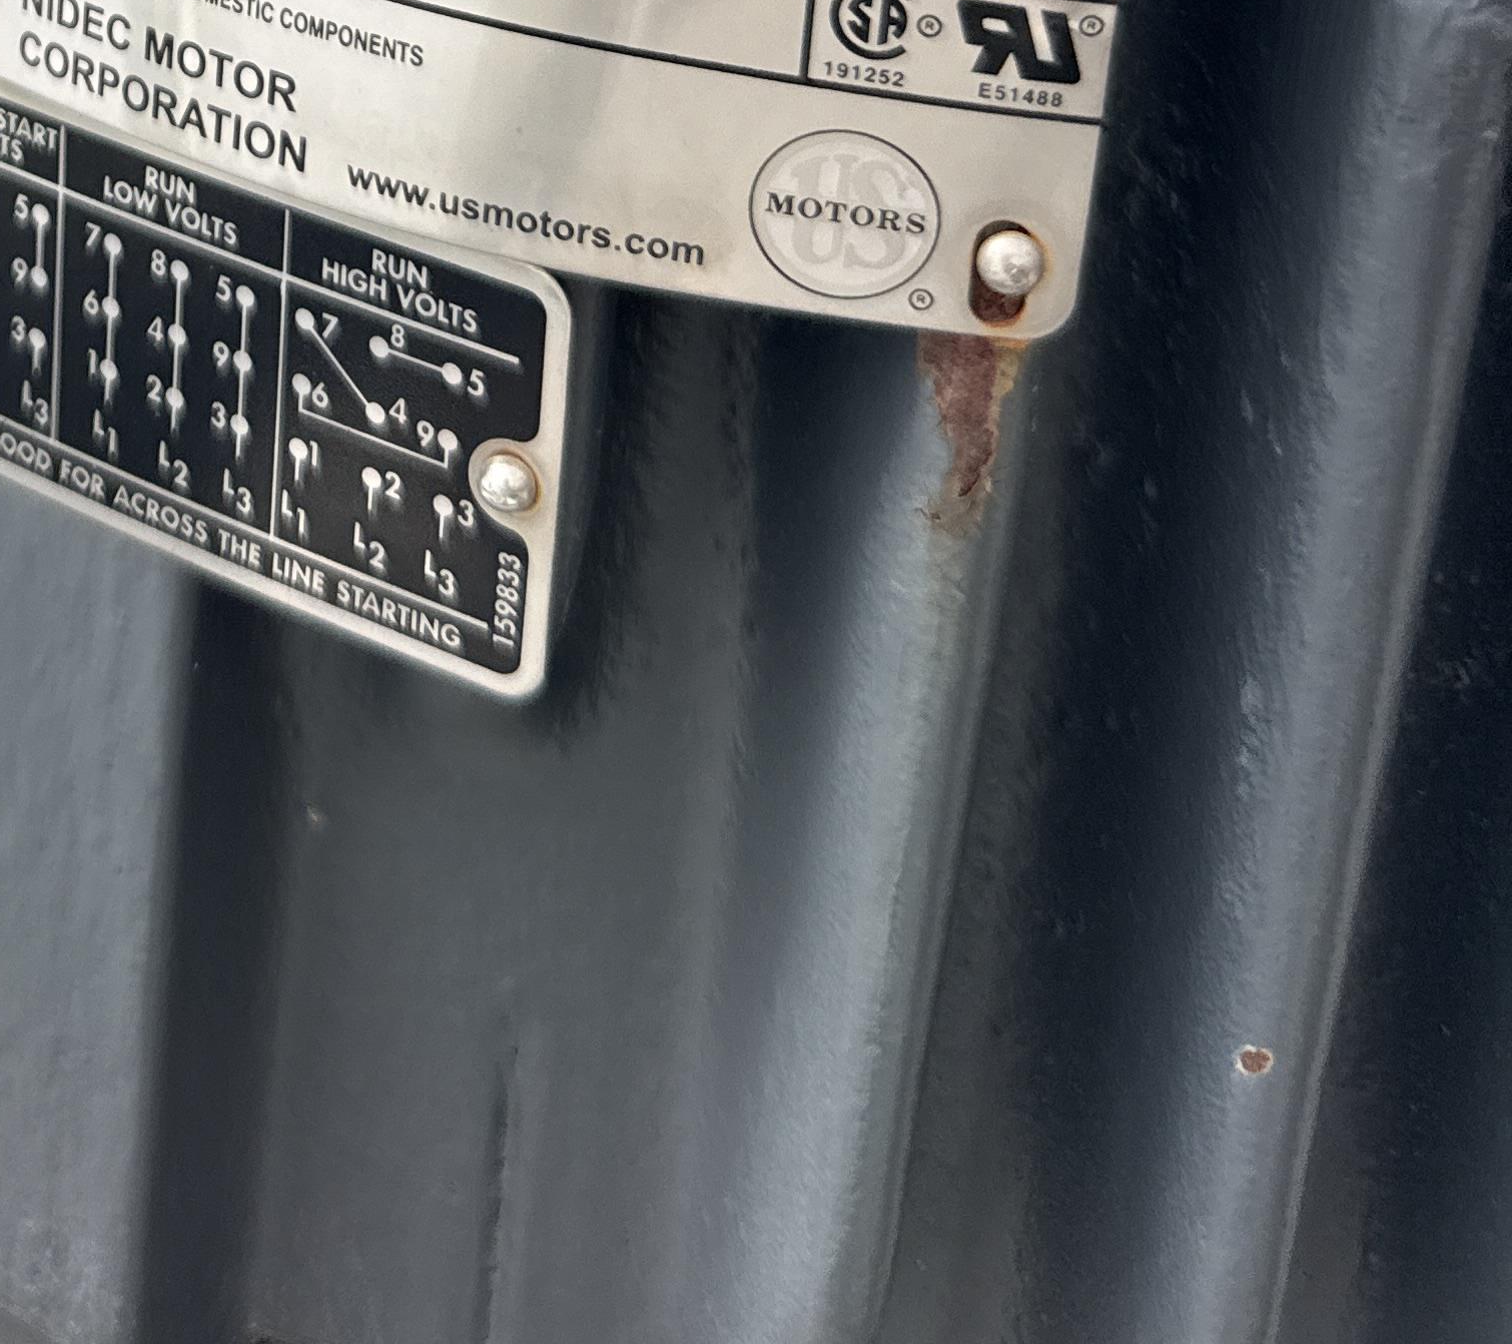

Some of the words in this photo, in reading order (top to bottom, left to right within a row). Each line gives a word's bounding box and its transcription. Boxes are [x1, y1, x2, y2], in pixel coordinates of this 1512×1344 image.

[144, 26, 296, 111] MOTOR
[280, 7, 425, 68] COMPONENTS
[19, 30, 307, 173] CORPORATION
[823, 61, 906, 87] 191252
[978, 82, 1064, 109] E51488
[103, 175, 156, 212] LOW
[166, 199, 239, 246] VOLTS
[145, 165, 196, 206] RUN
[347, 164, 705, 266] www.usmotors.com
[765, 191, 926, 234] MOTORS
[322, 258, 386, 301] HIGH
[396, 282, 478, 332] VOLTS
[371, 248, 429, 289] RUN
[58, 461, 105, 499] FOR
[113, 485, 209, 543] ACROSS
[218, 528, 262, 570] THE
[272, 549, 325, 595] LINE
[336, 581, 463, 647] STARTING
[492, 551, 523, 649] 159833
